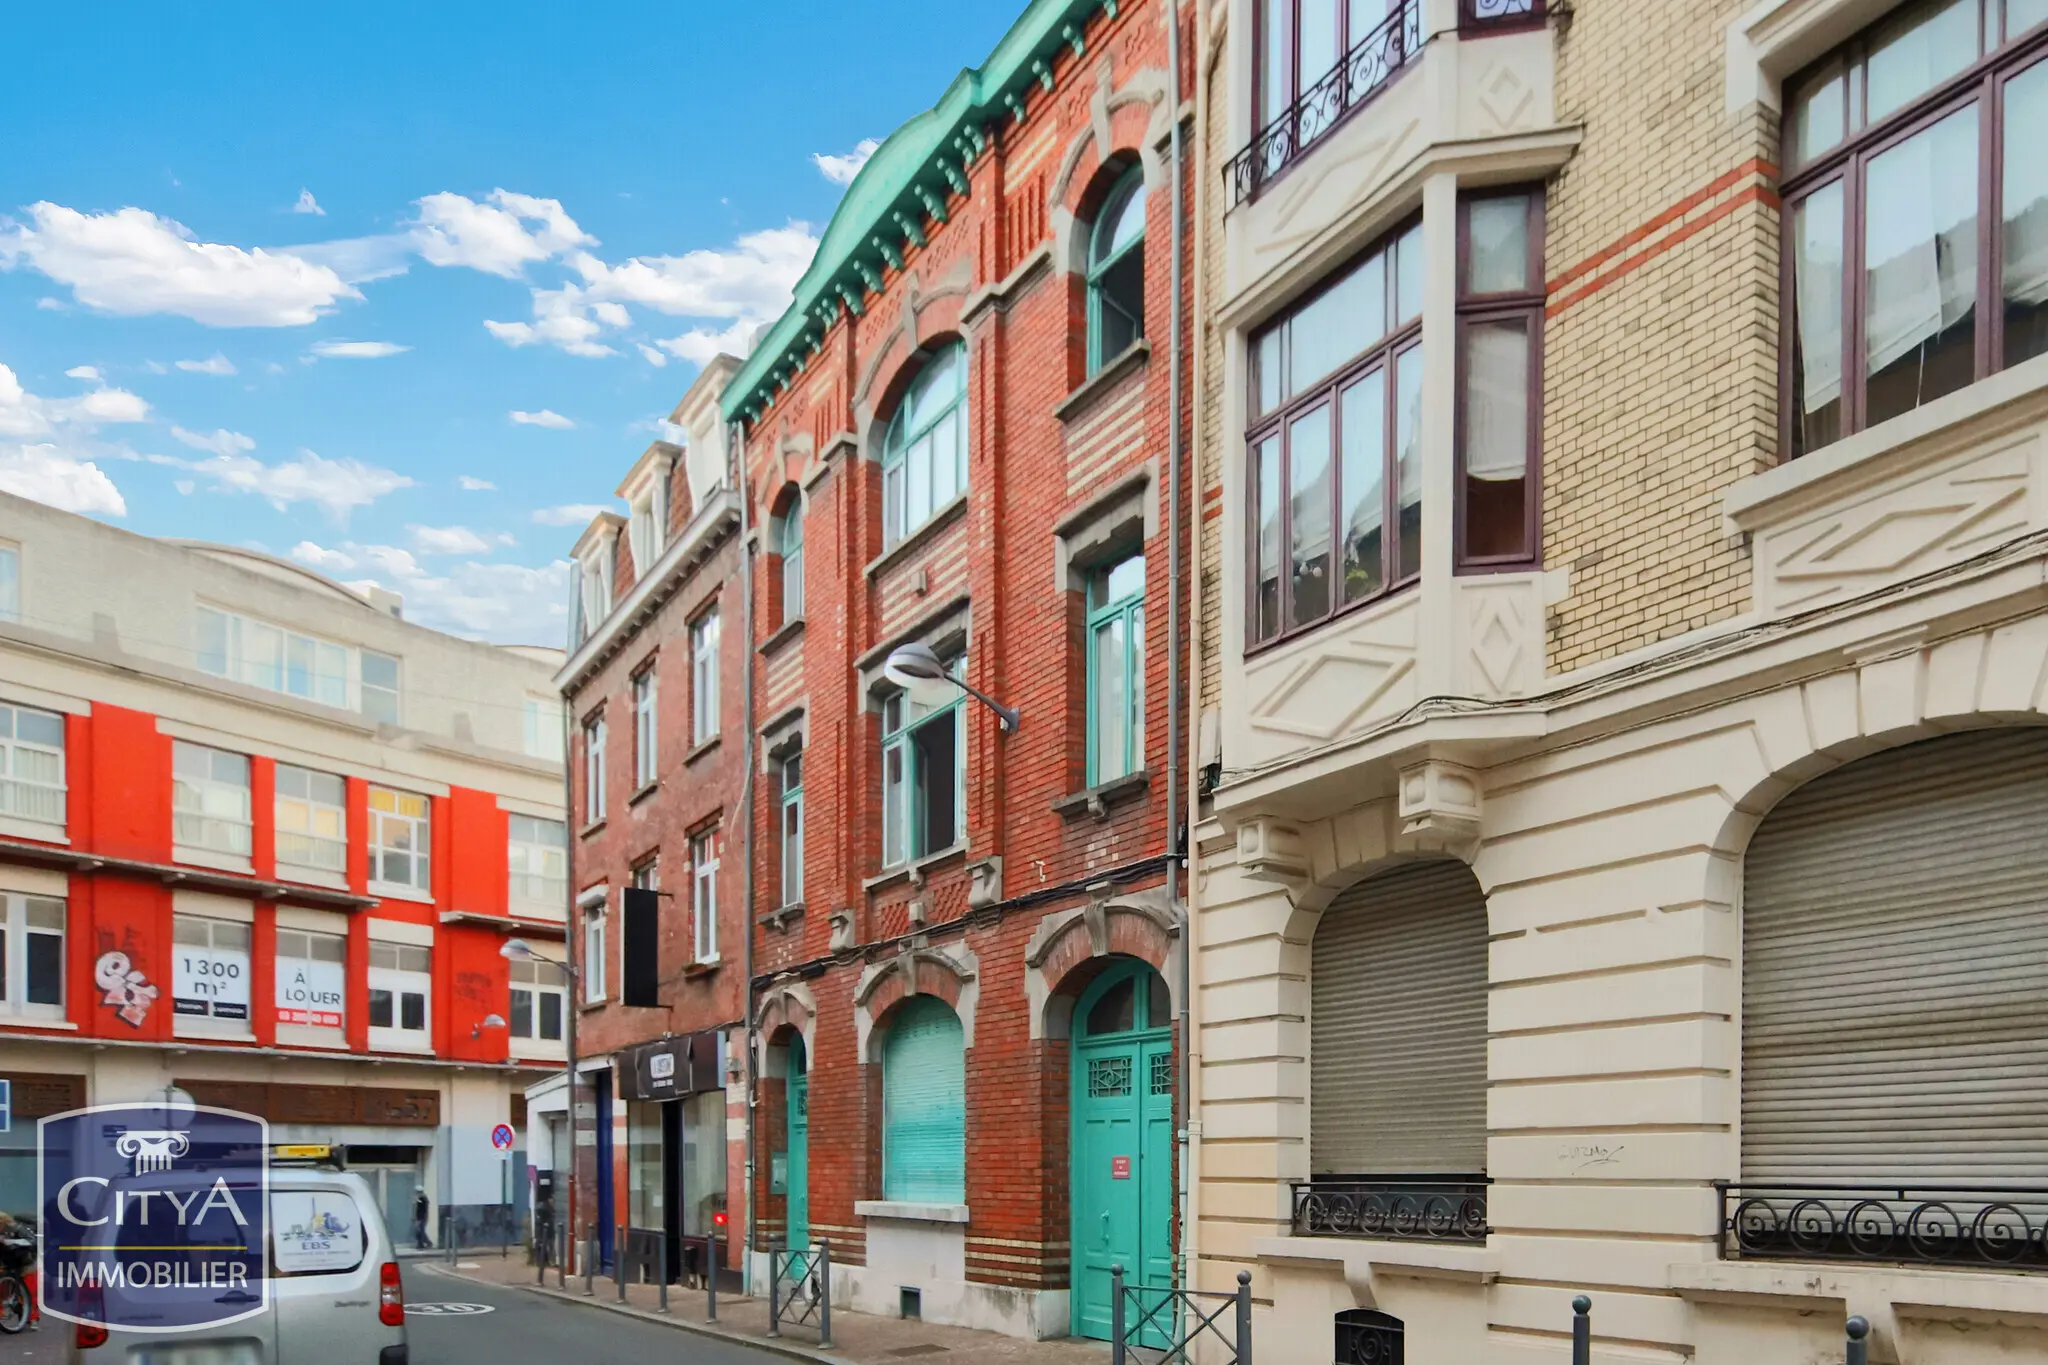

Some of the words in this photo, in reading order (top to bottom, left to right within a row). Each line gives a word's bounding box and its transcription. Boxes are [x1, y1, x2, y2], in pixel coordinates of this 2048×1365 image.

[294, 968, 306, 984] À
[286, 988, 341, 1005] LOUER
[301, 1241, 332, 1251] EBS
